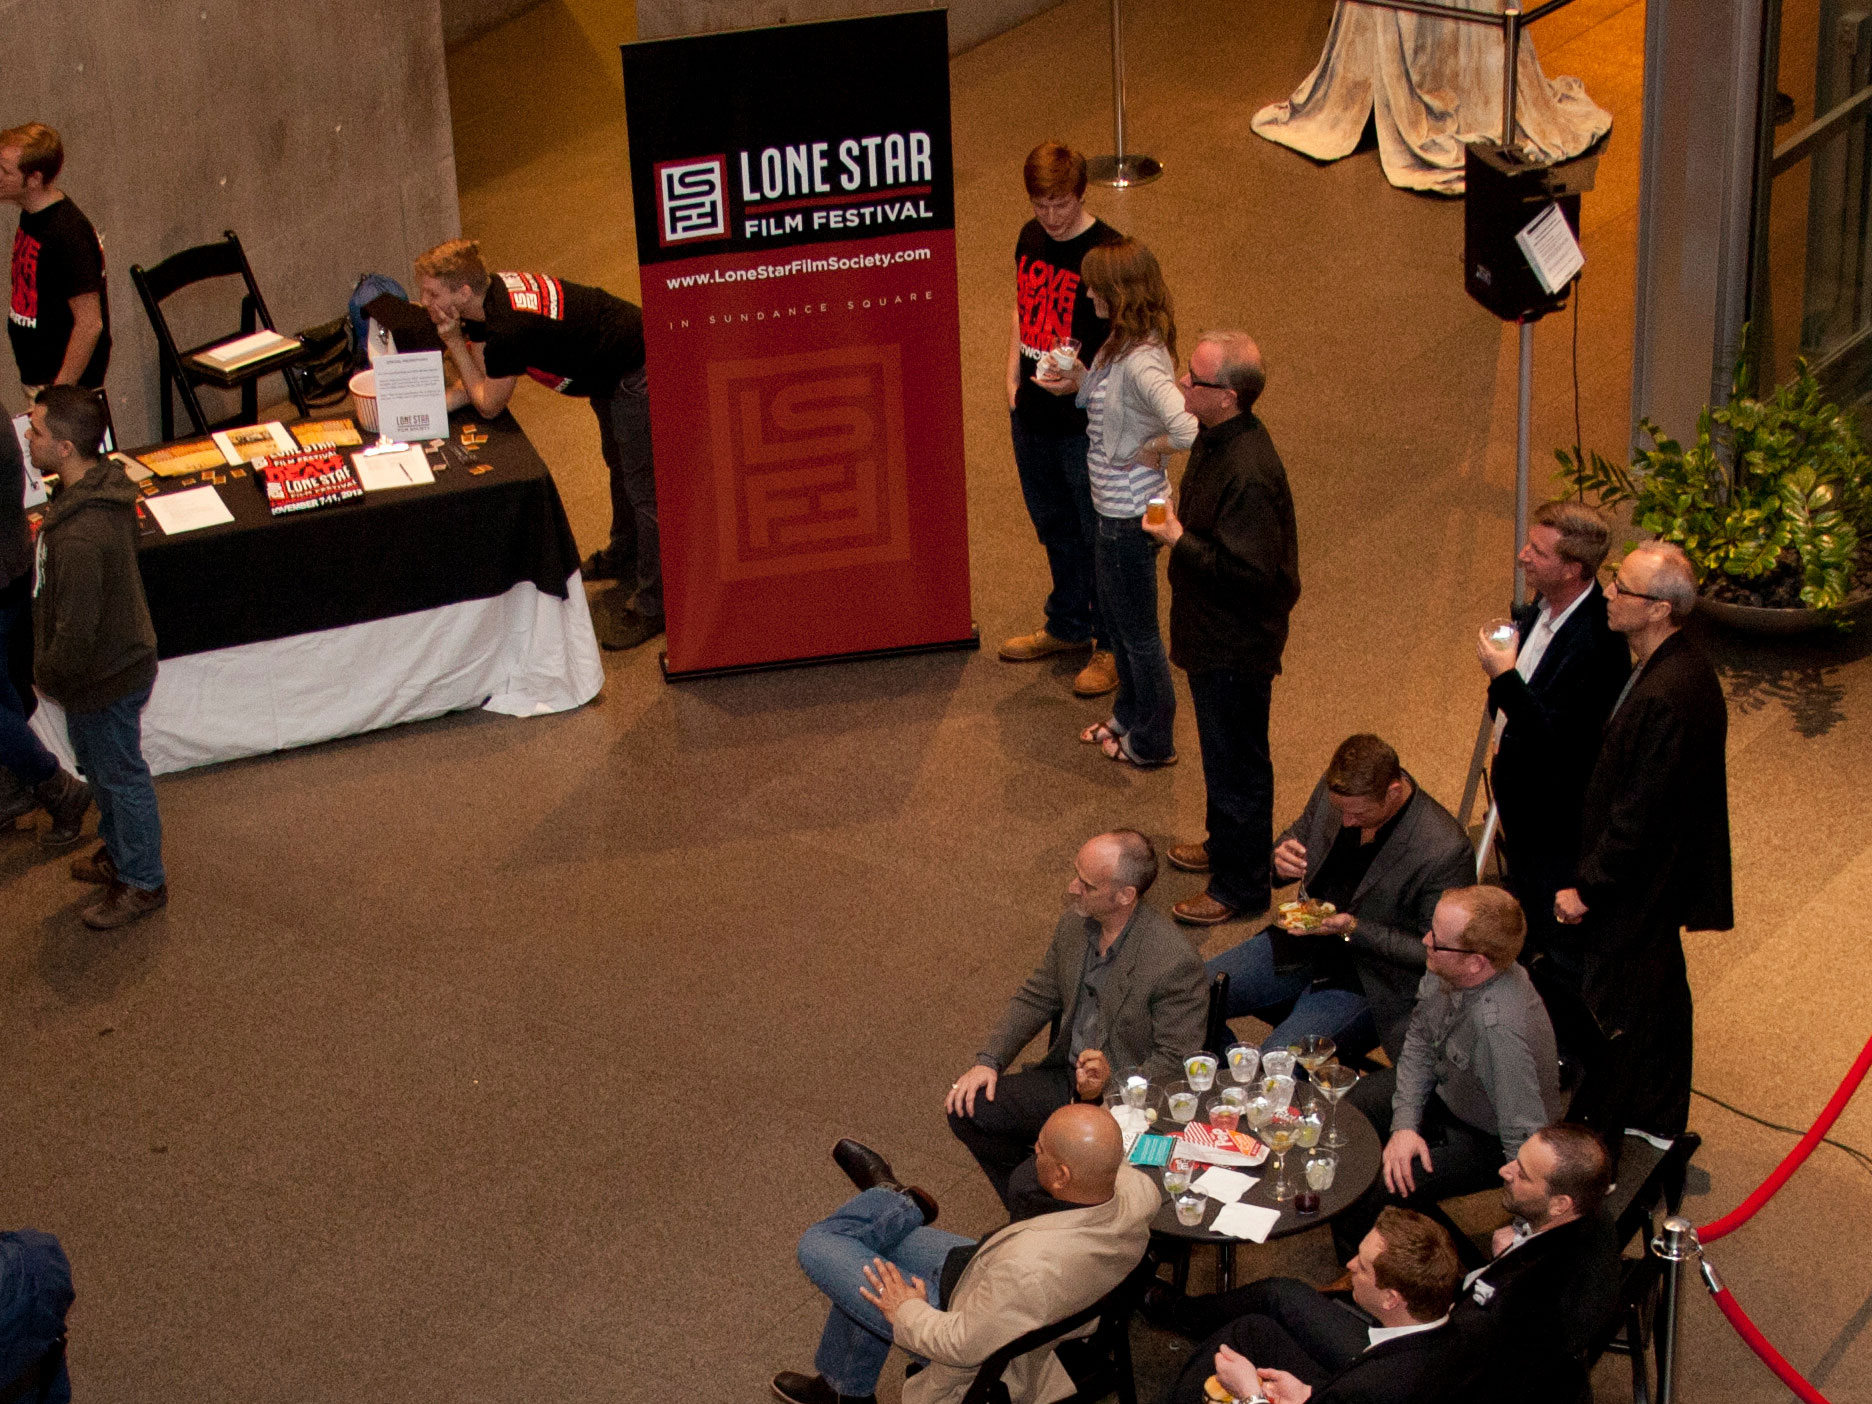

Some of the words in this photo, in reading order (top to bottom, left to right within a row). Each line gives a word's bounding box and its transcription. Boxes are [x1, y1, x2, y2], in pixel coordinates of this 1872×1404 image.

[740, 142, 831, 202] LONE
[839, 131, 932, 191] STAR
[745, 213, 804, 239] FILM
[813, 200, 933, 230] FESTIVAL
[666, 247, 932, 289] www.LoneStarFilmSociety.com
[1018, 256, 1081, 292] LOVE
[669, 319, 690, 330] IN
[709, 303, 828, 324] SUNDANCE
[847, 291, 933, 310] SQUARE
[285, 478, 319, 494] LONE
